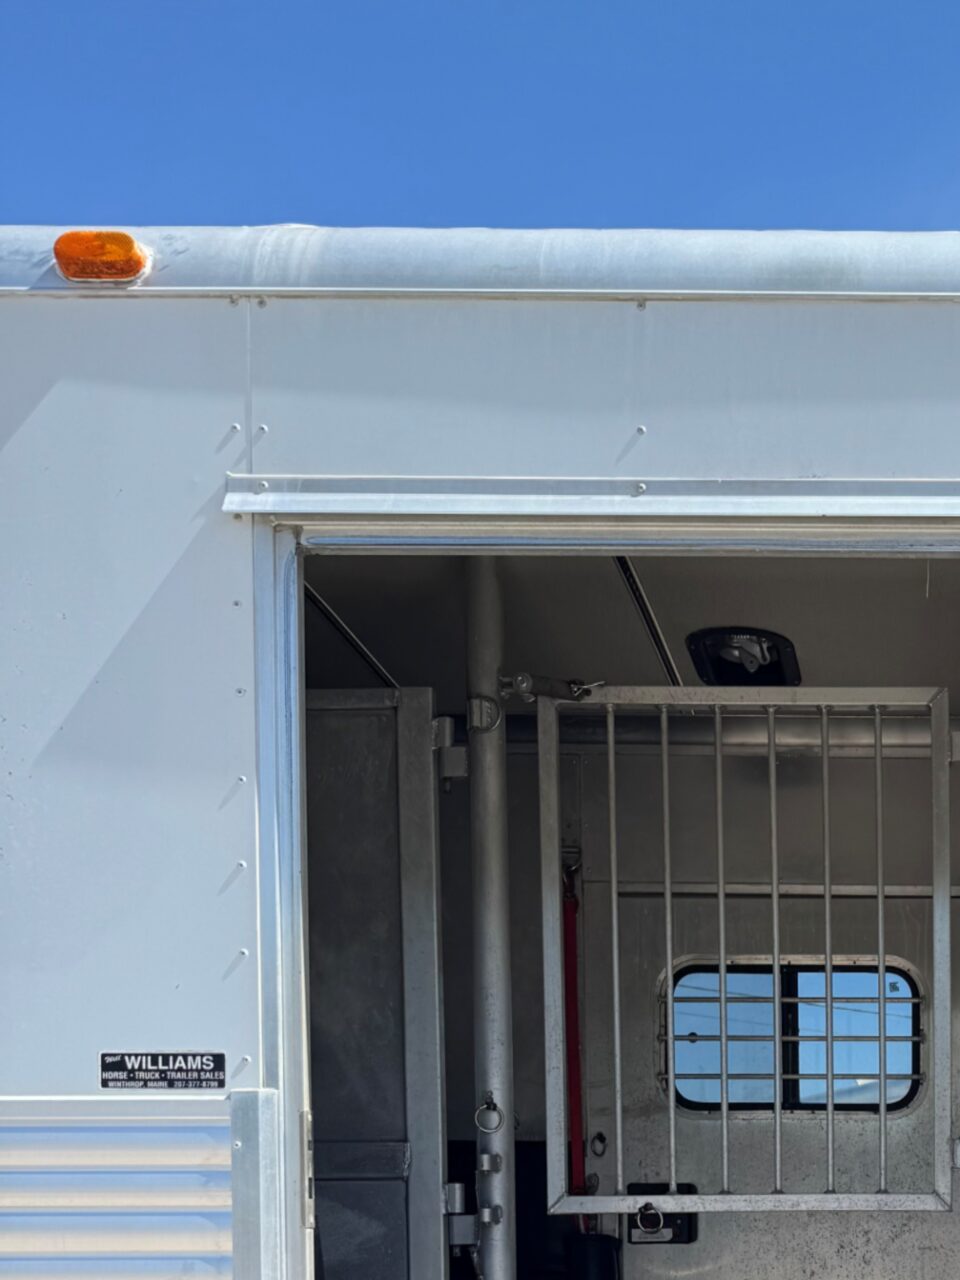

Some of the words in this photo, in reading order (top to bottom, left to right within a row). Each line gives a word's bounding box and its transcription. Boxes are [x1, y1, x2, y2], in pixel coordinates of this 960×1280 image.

[124, 1055, 215, 1070] WILLIAMS
[102, 1071, 128, 1080] HORSE
[134, 1071, 161, 1080] TRUCK
[166, 1071, 199, 1080] TRAILER
[200, 1071, 225, 1080] SALES
